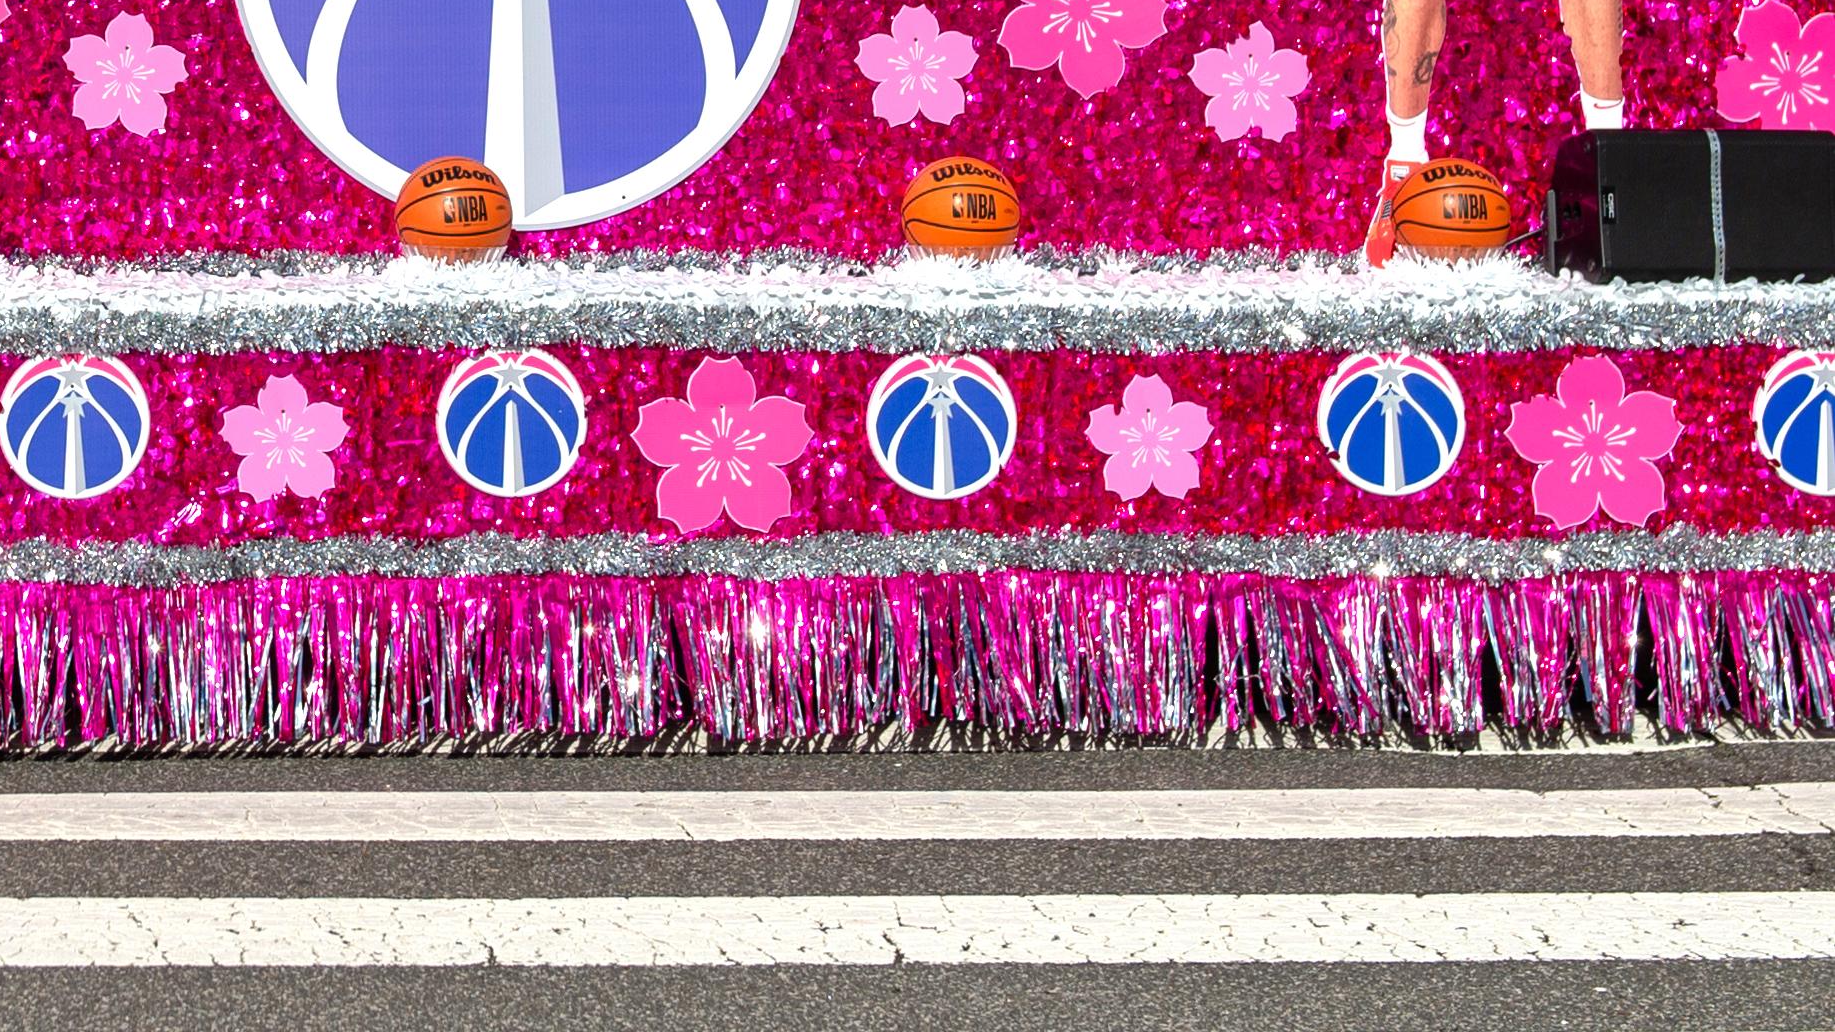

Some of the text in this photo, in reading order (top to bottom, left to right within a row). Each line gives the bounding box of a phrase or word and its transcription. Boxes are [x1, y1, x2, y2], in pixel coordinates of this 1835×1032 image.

[421, 166, 497, 187] Wilson
[930, 163, 1007, 185] Wilson
[1421, 164, 1499, 187] Wilson
[457, 194, 488, 223] NBA
[967, 193, 996, 220] NBA
[1458, 193, 1488, 220] NBA
